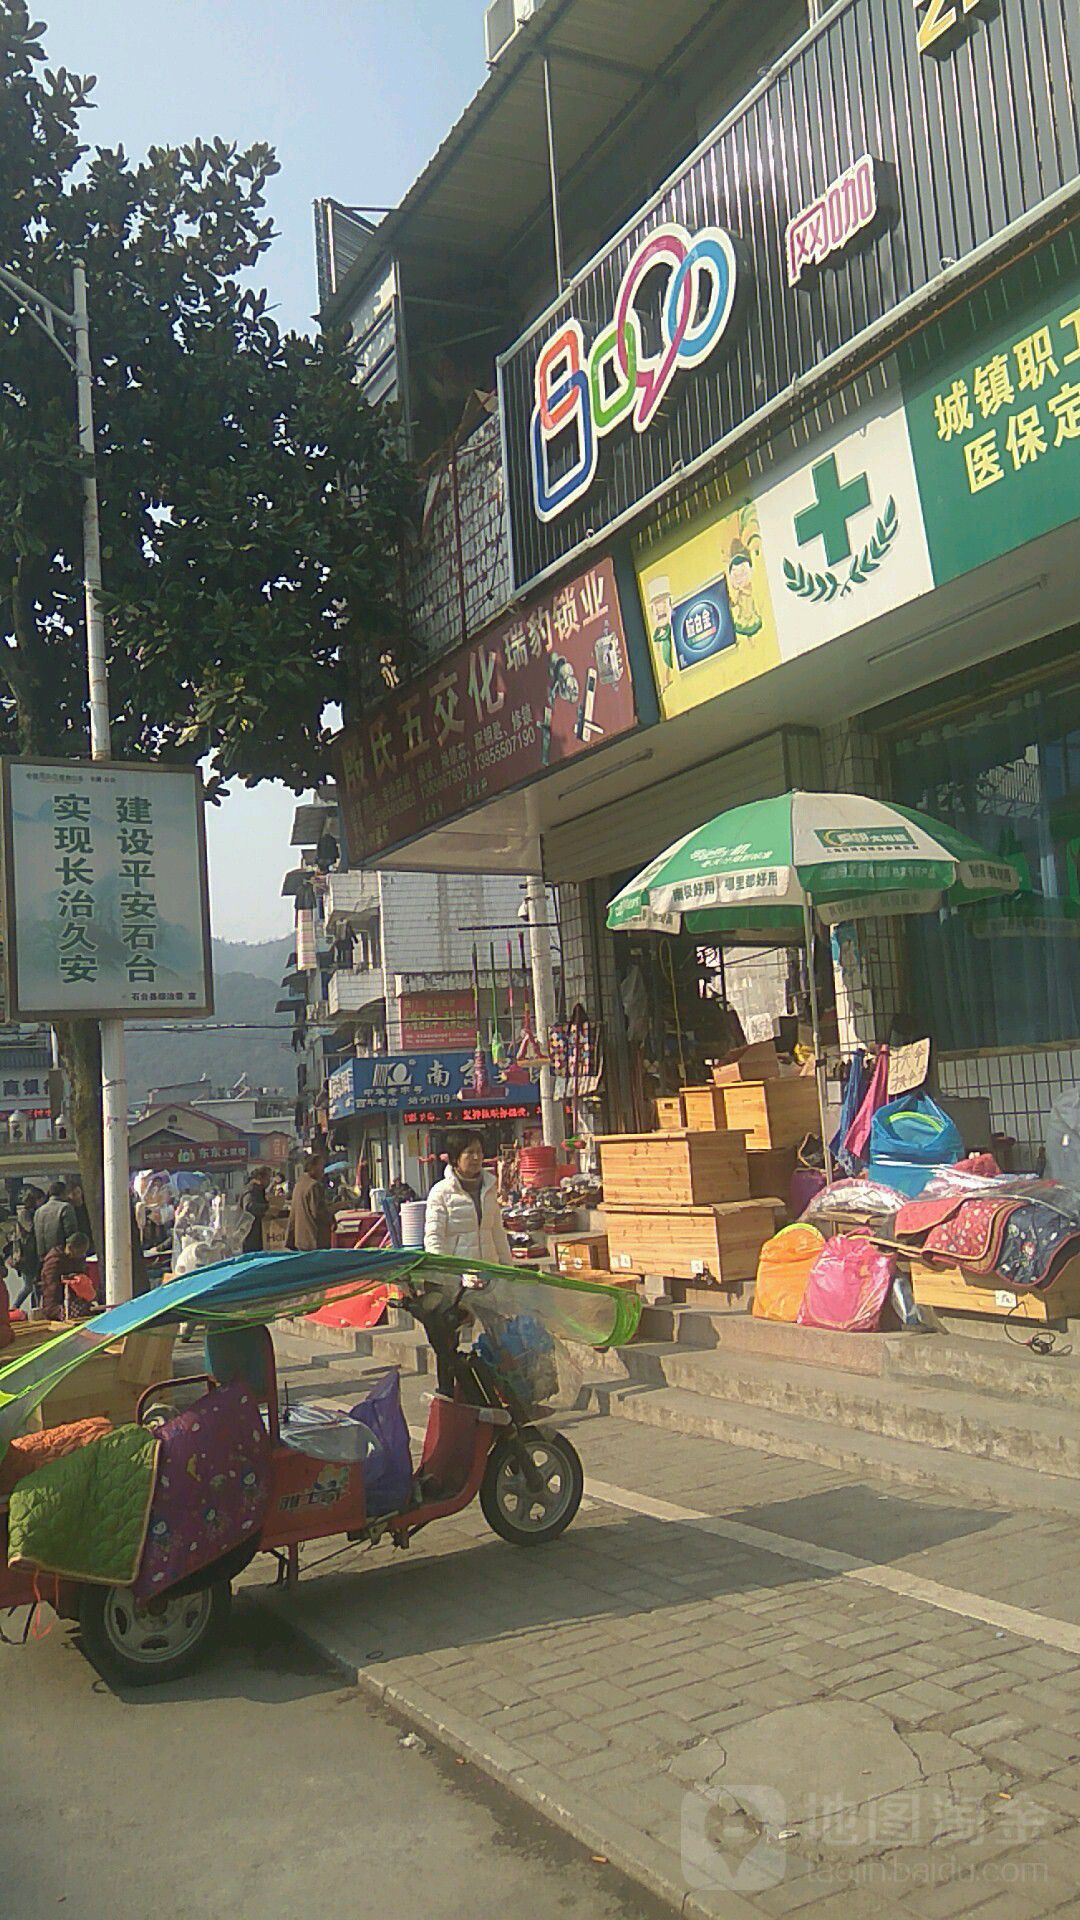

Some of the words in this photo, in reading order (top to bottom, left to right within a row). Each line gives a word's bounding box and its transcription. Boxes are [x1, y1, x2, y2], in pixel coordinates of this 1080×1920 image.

[787, 153, 877, 288] 网咖
[503, 570, 609, 672] 瑞豹锁业
[53, 793, 99, 984] 实现长治久安
[115, 796, 158, 983] 建设平安石台
